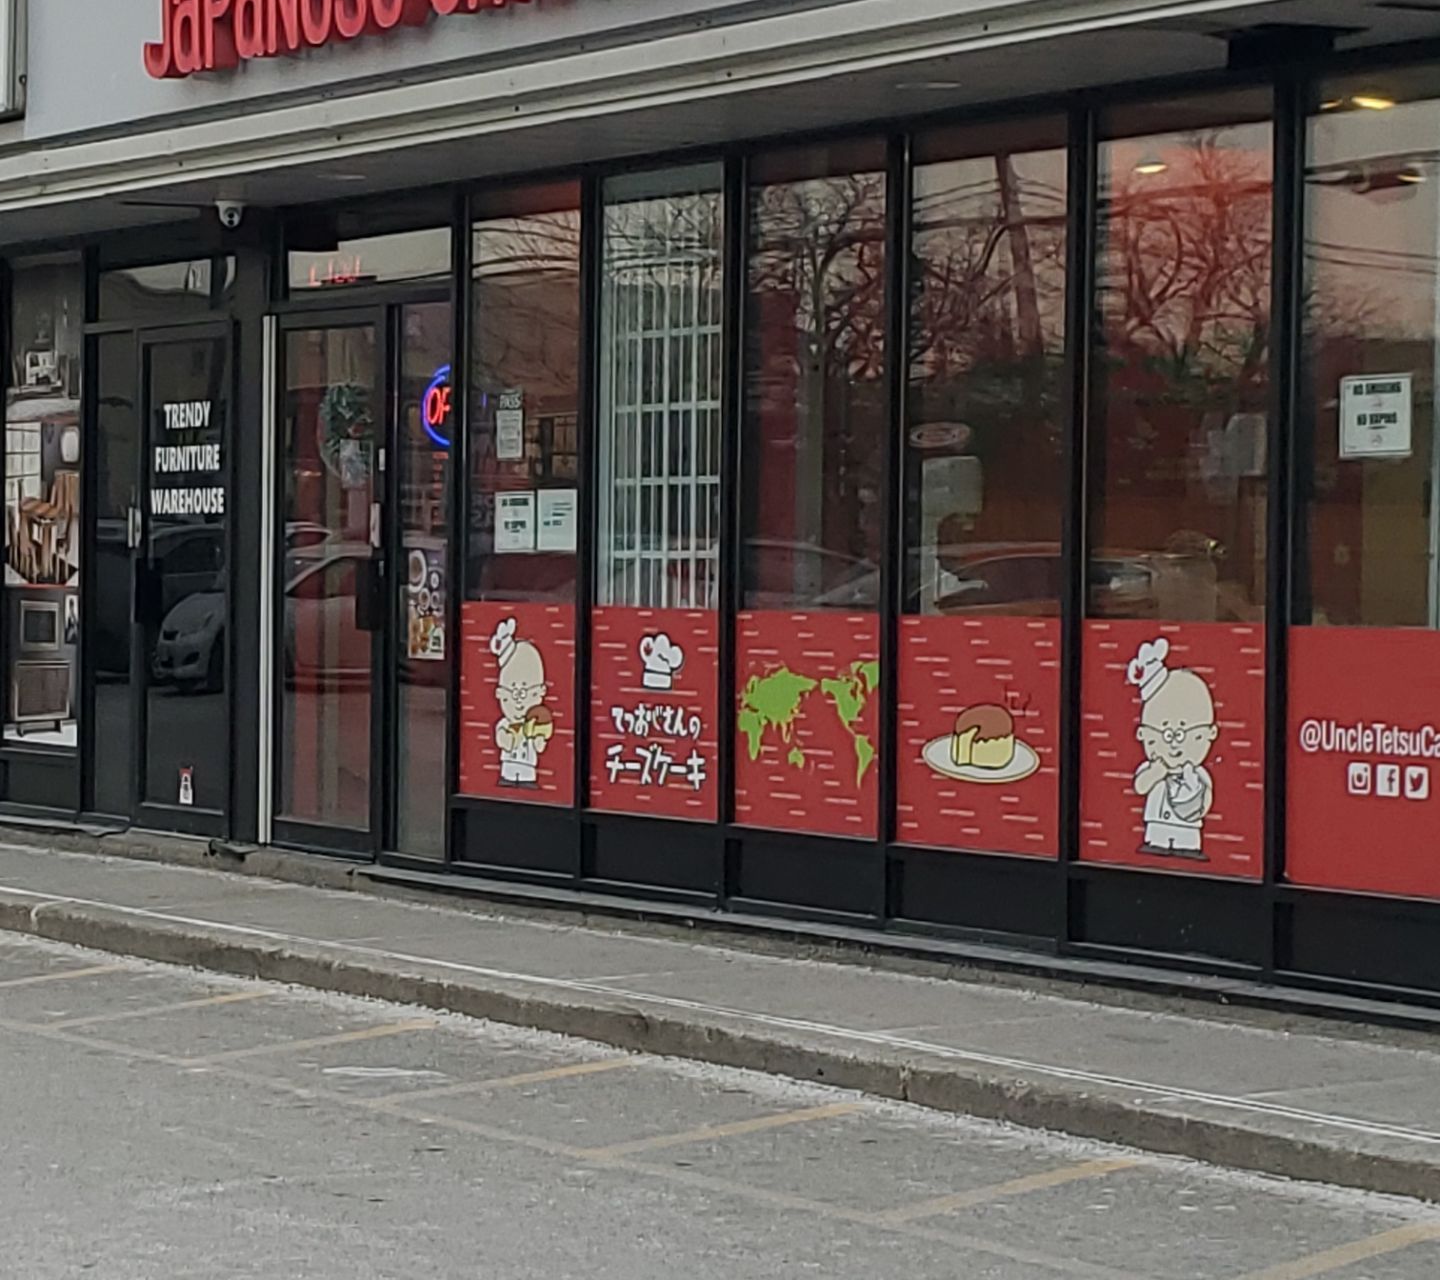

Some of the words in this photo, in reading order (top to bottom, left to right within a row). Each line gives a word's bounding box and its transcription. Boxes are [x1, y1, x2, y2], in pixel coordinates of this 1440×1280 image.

[163, 401, 211, 429] TRENDY
[155, 444, 220, 472] FURNITURE
[151, 487, 224, 514] WAREHOUSE
[606, 743, 706, 790] チーズケーキ
